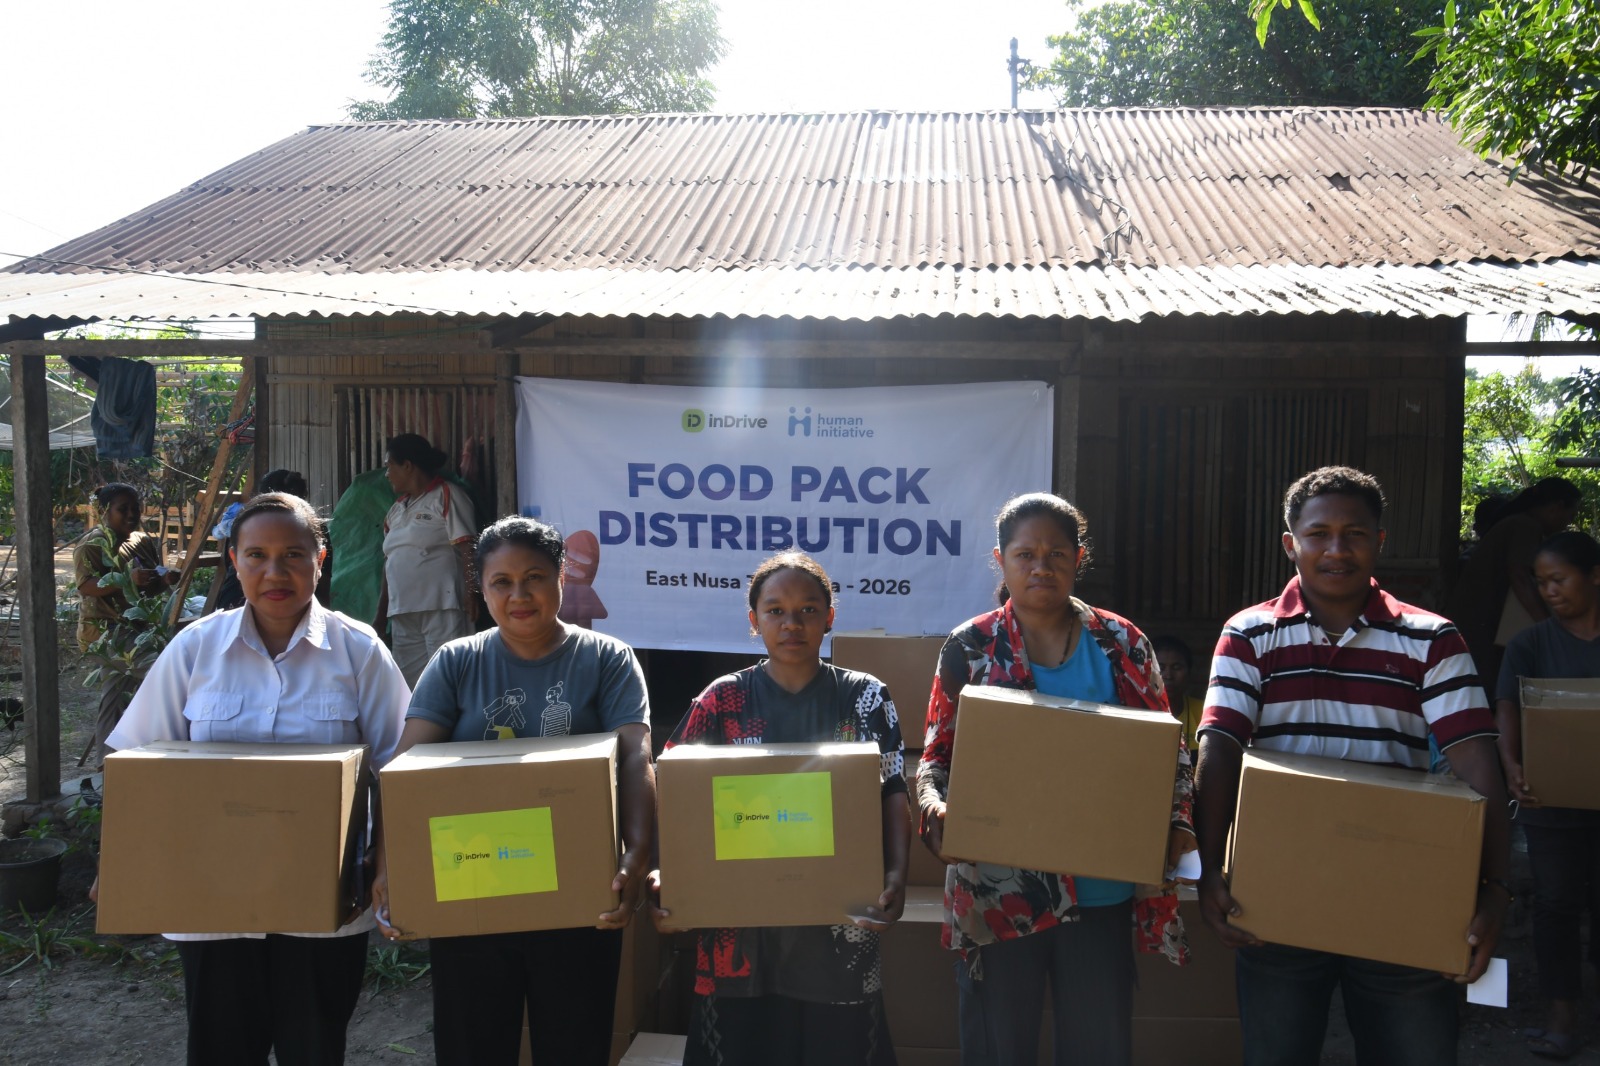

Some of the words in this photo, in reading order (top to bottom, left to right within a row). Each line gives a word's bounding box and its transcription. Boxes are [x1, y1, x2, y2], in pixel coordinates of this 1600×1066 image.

[708, 414, 768, 429] inDrive
[817, 413, 863, 426] human
[816, 426, 875, 438] initiative
[627, 462, 774, 501] FOOD
[790, 465, 931, 505] PACK
[599, 510, 962, 557] DISTRIBUTION
[646, 570, 688, 587] East
[693, 572, 741, 589] Nusa
[859, 578, 911, 596] 2026
[745, 813, 770, 821] inDrive
[465, 852, 491, 860] inDrive
